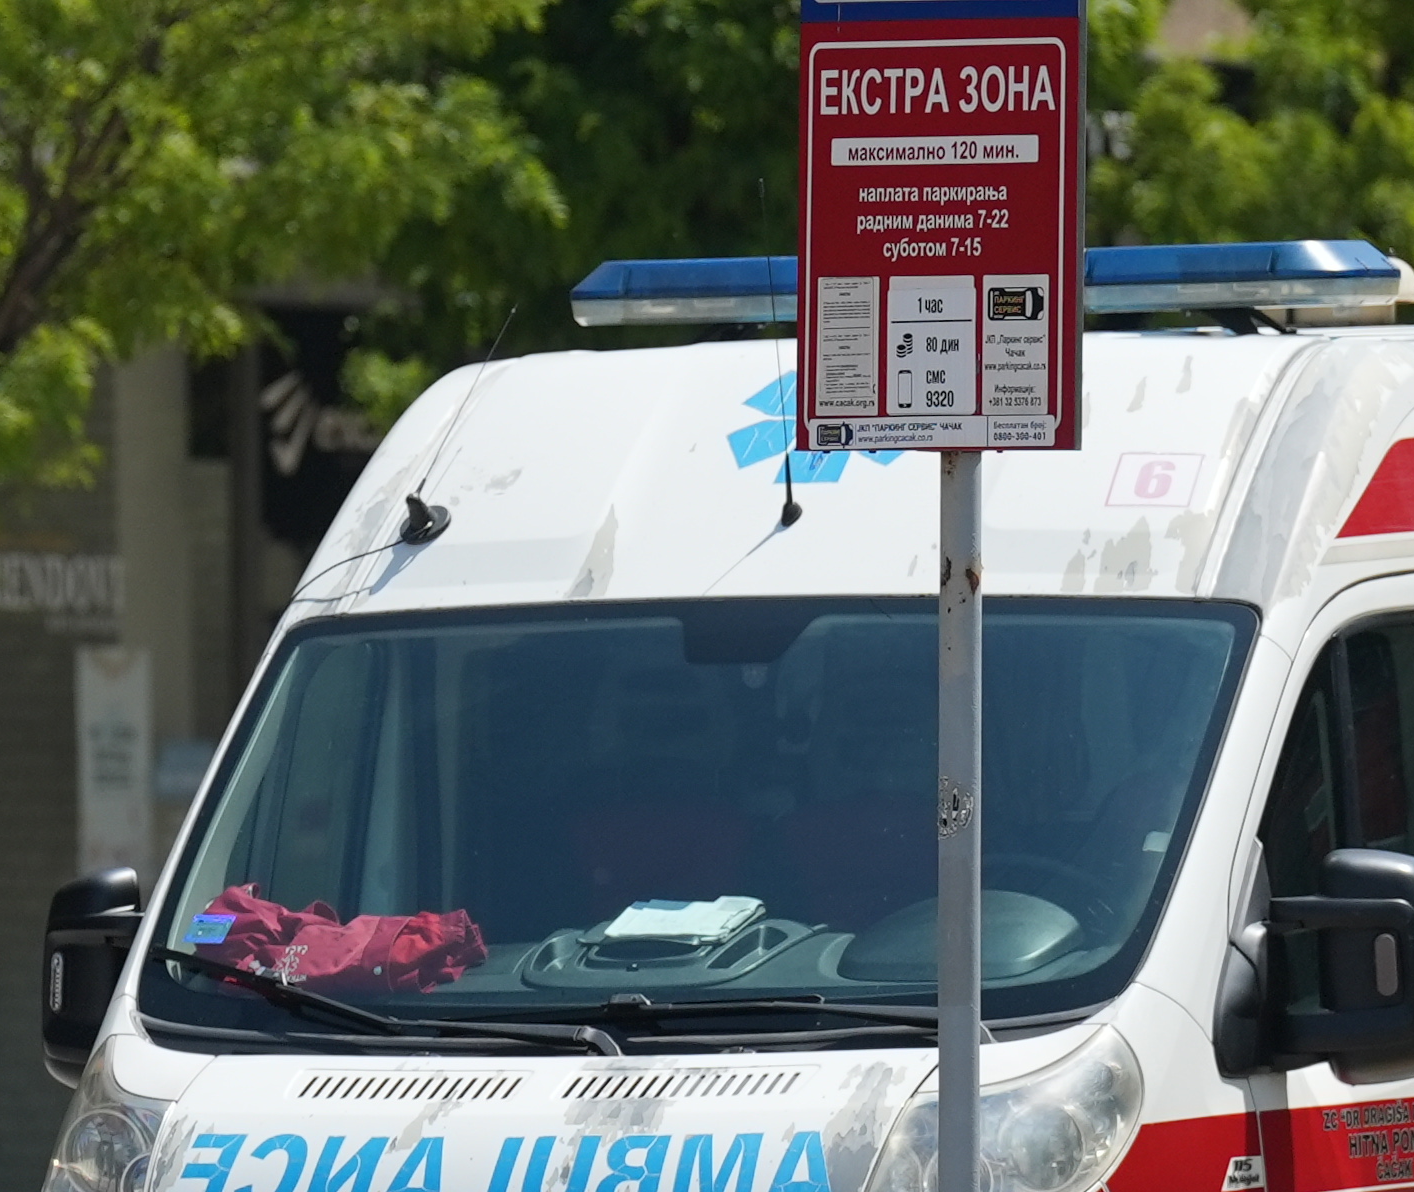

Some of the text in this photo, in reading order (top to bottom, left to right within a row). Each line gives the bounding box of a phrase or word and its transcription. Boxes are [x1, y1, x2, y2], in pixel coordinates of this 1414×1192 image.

[820, 65, 1056, 115] ЕКСТРА ЗОНА
[848, 141, 1019, 161] максимално 120 мин.
[858, 186, 1007, 205] наплата паркирања
[857, 209, 1009, 234] радним данима 7-22
[883, 237, 982, 261] суботом 7-15
[917, 297, 944, 314] 1 час
[926, 337, 960, 355] 80 дин
[926, 390, 954, 408] 9320
[1134, 460, 1176, 499] 6
[1348, 1132, 1389, 1158] HITNA
[1233, 1158, 1253, 1172] 115
